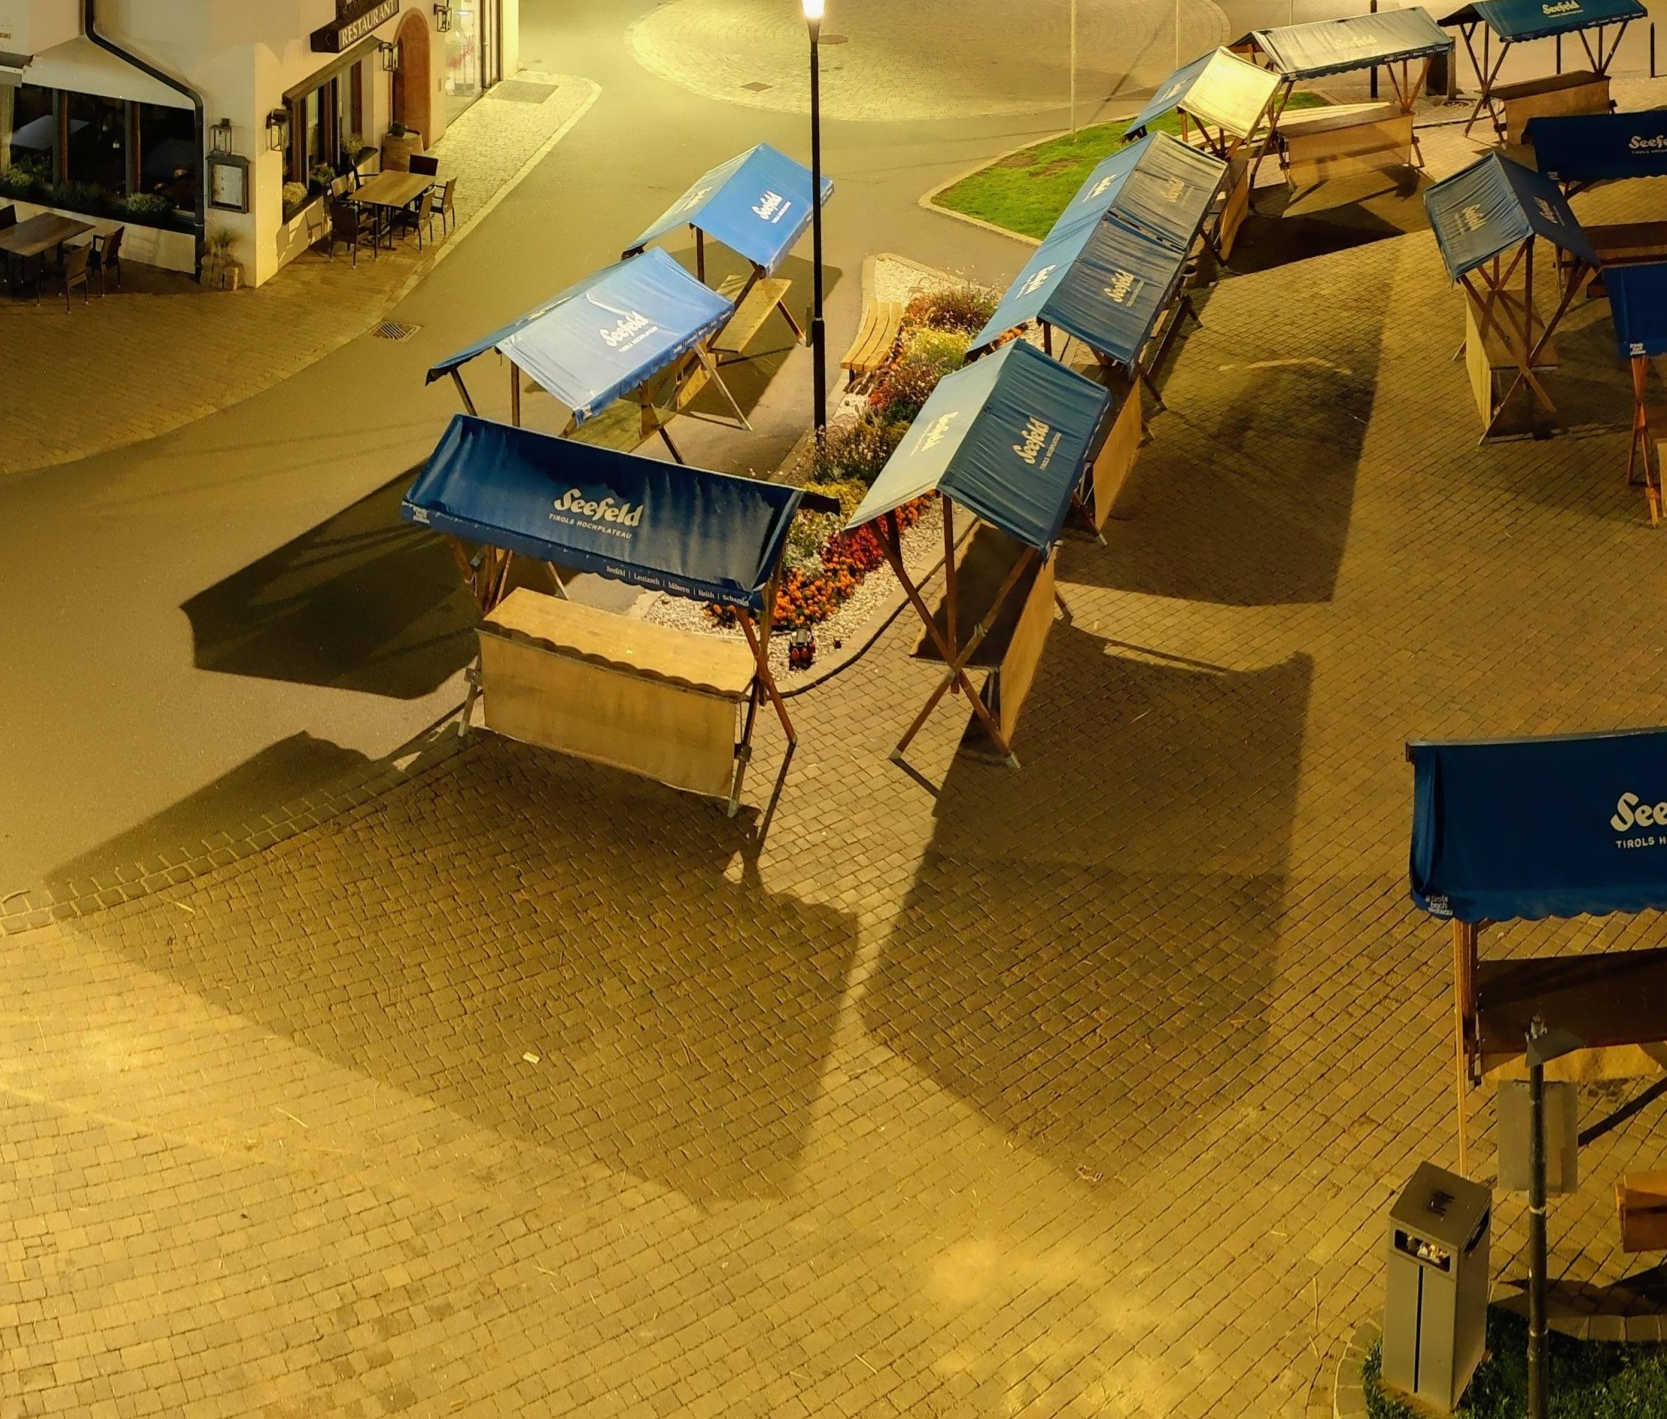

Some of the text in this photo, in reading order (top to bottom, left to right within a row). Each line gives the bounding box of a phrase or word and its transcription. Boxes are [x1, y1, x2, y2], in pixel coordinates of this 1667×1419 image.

[553, 488, 644, 528] Seefeld
[548, 512, 632, 540] TIROLS HOCHPLATEAU
[633, 571, 661, 586] Leutasch
[1615, 836, 1656, 849] TIROLS
